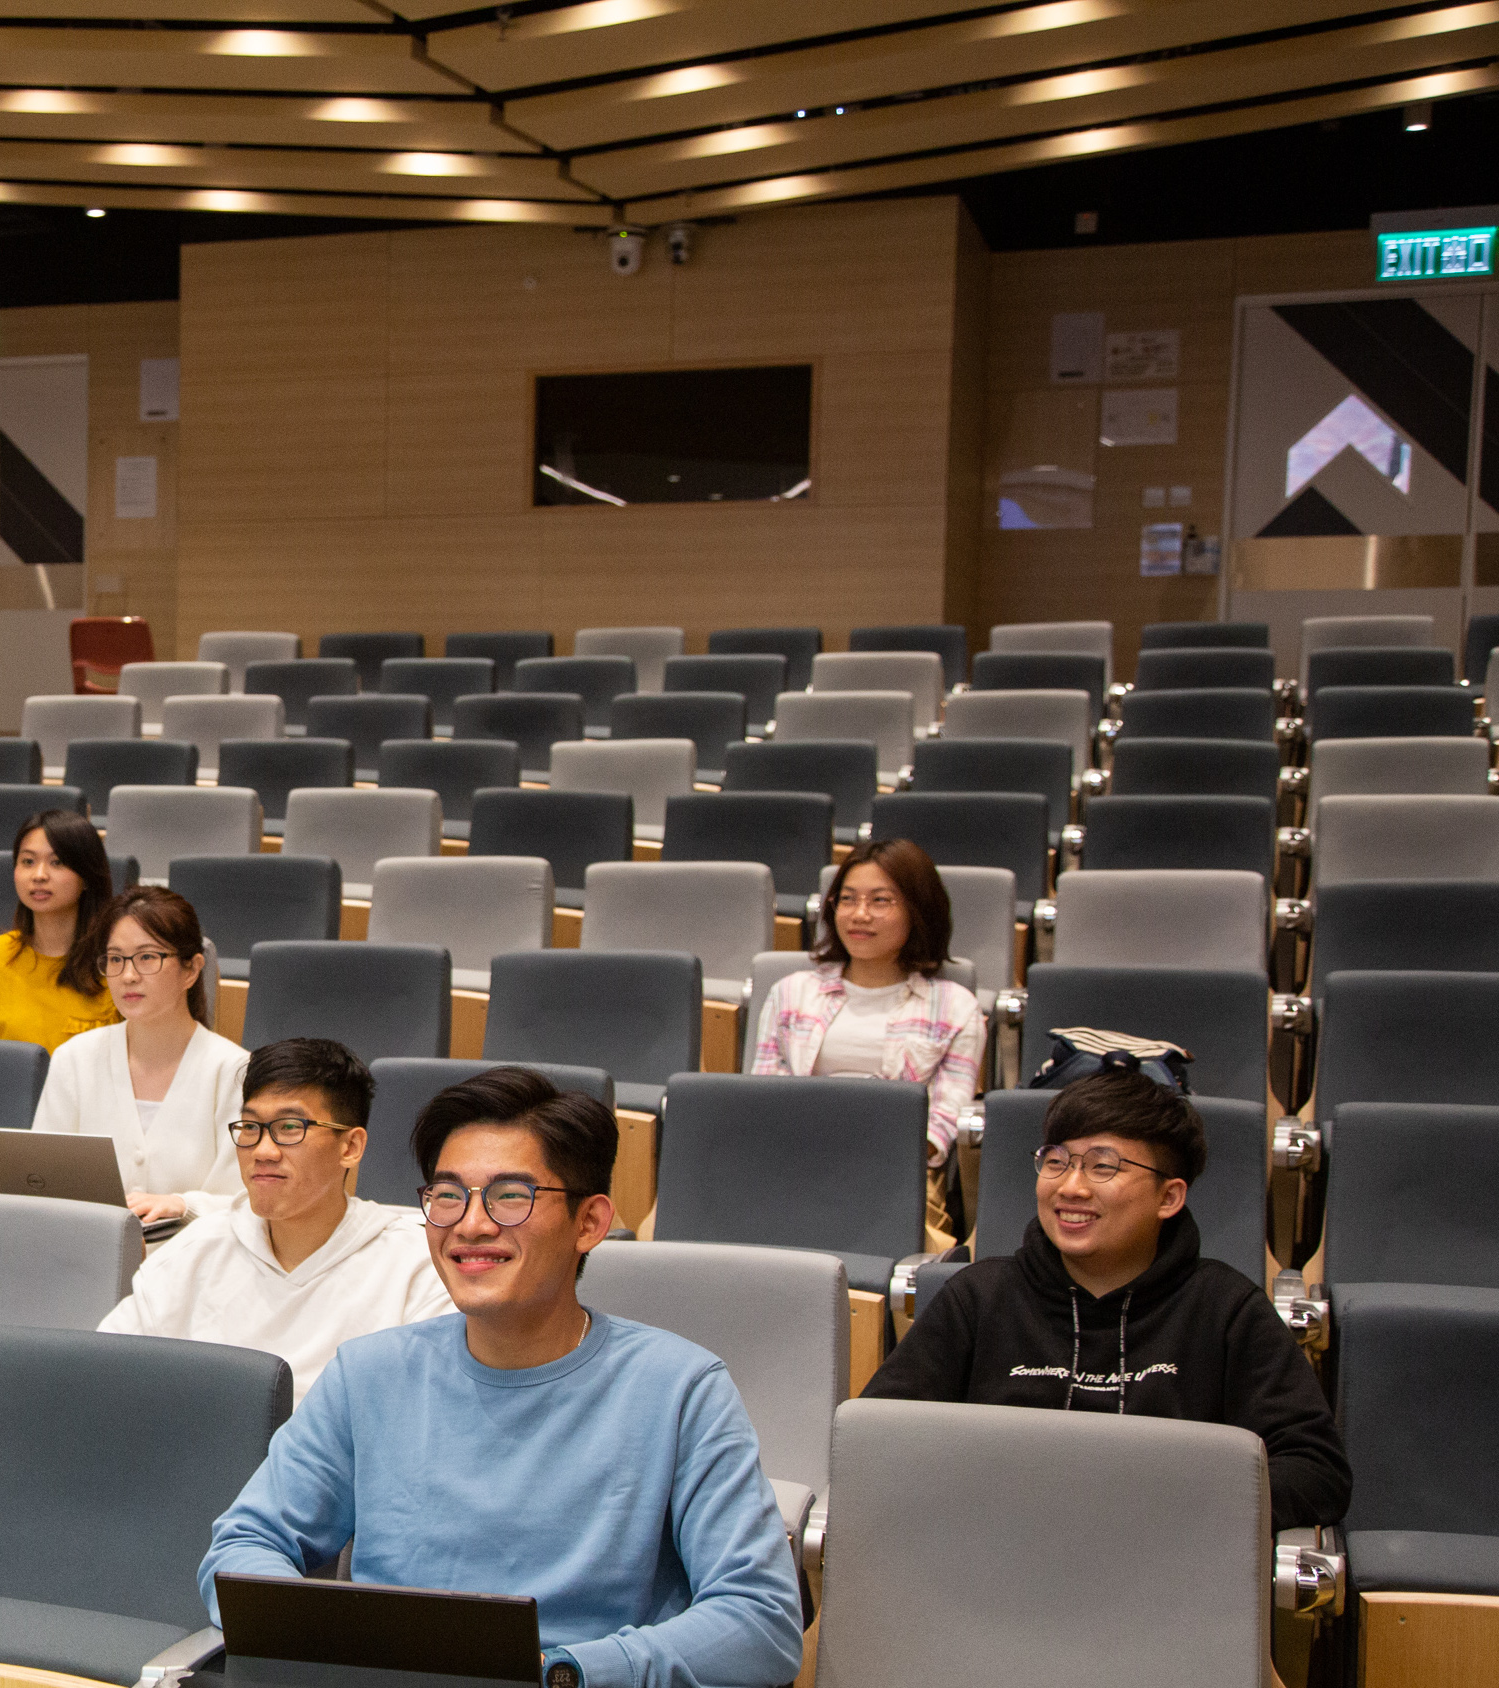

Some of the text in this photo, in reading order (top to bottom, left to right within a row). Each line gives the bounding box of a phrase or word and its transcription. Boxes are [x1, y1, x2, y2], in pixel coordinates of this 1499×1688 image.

[1381, 237, 1441, 277] EXIT
[1009, 1365, 1070, 1379] SOMEWHERE
[1085, 1374, 1106, 1383] THE
